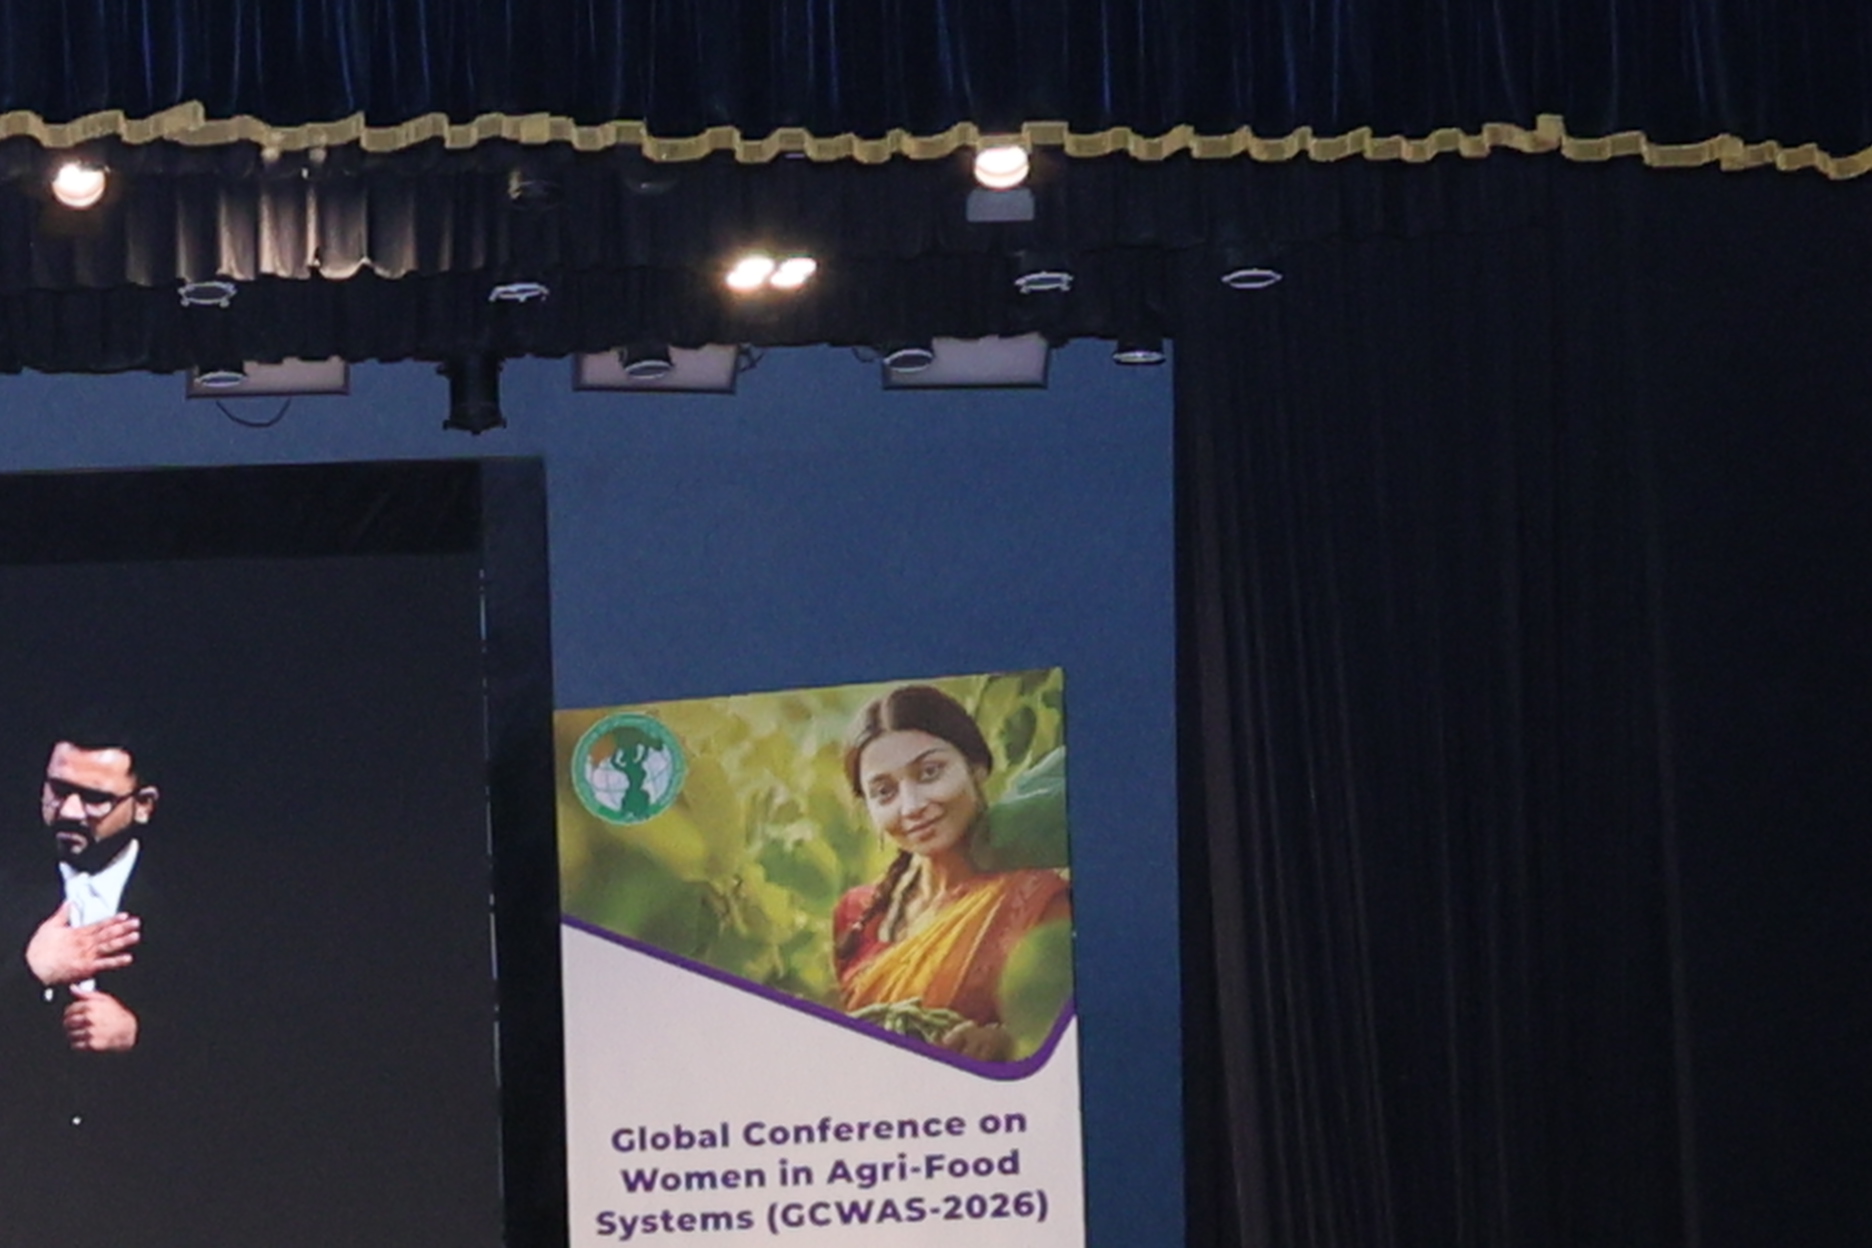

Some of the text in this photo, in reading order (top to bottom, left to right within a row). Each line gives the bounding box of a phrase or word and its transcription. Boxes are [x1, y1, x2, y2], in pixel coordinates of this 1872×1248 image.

[612, 1113, 1026, 1152] Global Conference on
[621, 1149, 1019, 1193] Women in Agri-Food
[596, 1190, 1048, 1241] Systems (GCWAS-2026)
